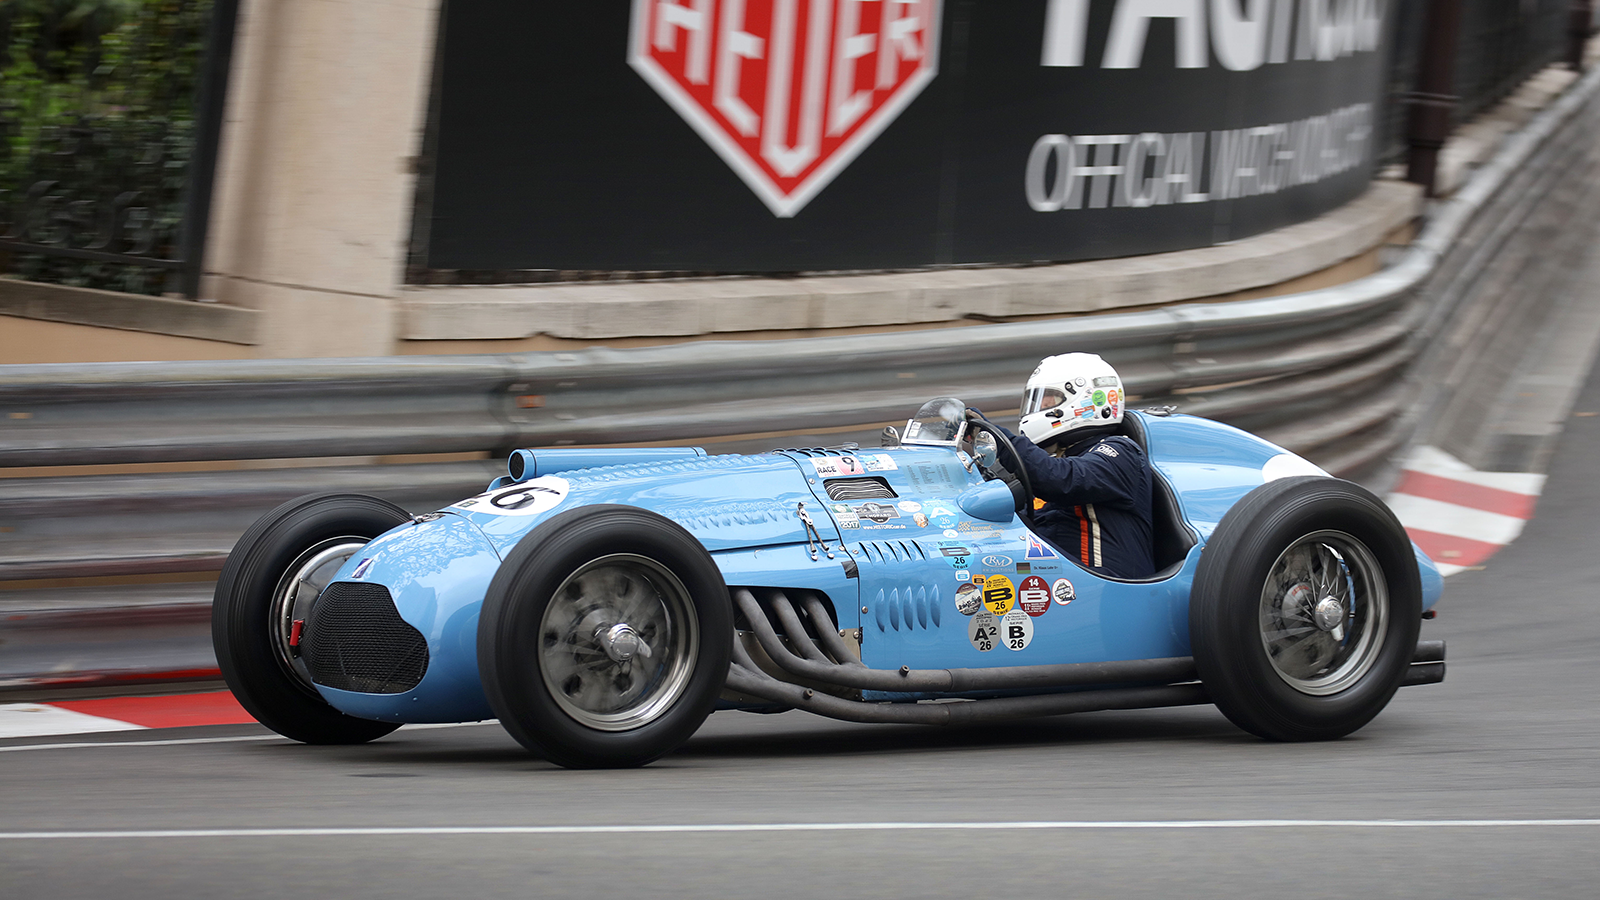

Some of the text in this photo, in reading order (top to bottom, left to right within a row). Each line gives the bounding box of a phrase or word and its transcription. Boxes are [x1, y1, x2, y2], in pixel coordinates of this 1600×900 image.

[1097, 445, 1118, 458] OMP
[817, 466, 837, 474] RACE
[842, 456, 854, 472] 9
[930, 507, 956, 518] A
[940, 517, 950, 525] 26
[939, 547, 971, 557] B
[954, 557, 966, 565] 26
[989, 556, 1005, 566] RM
[1029, 578, 1039, 587] 14
[984, 587, 1013, 603] B
[1020, 589, 1049, 604] B
[994, 601, 1006, 610] 26
[1009, 625, 1025, 639] B
[980, 641, 992, 650] 26
[1010, 639, 1024, 649] 26
